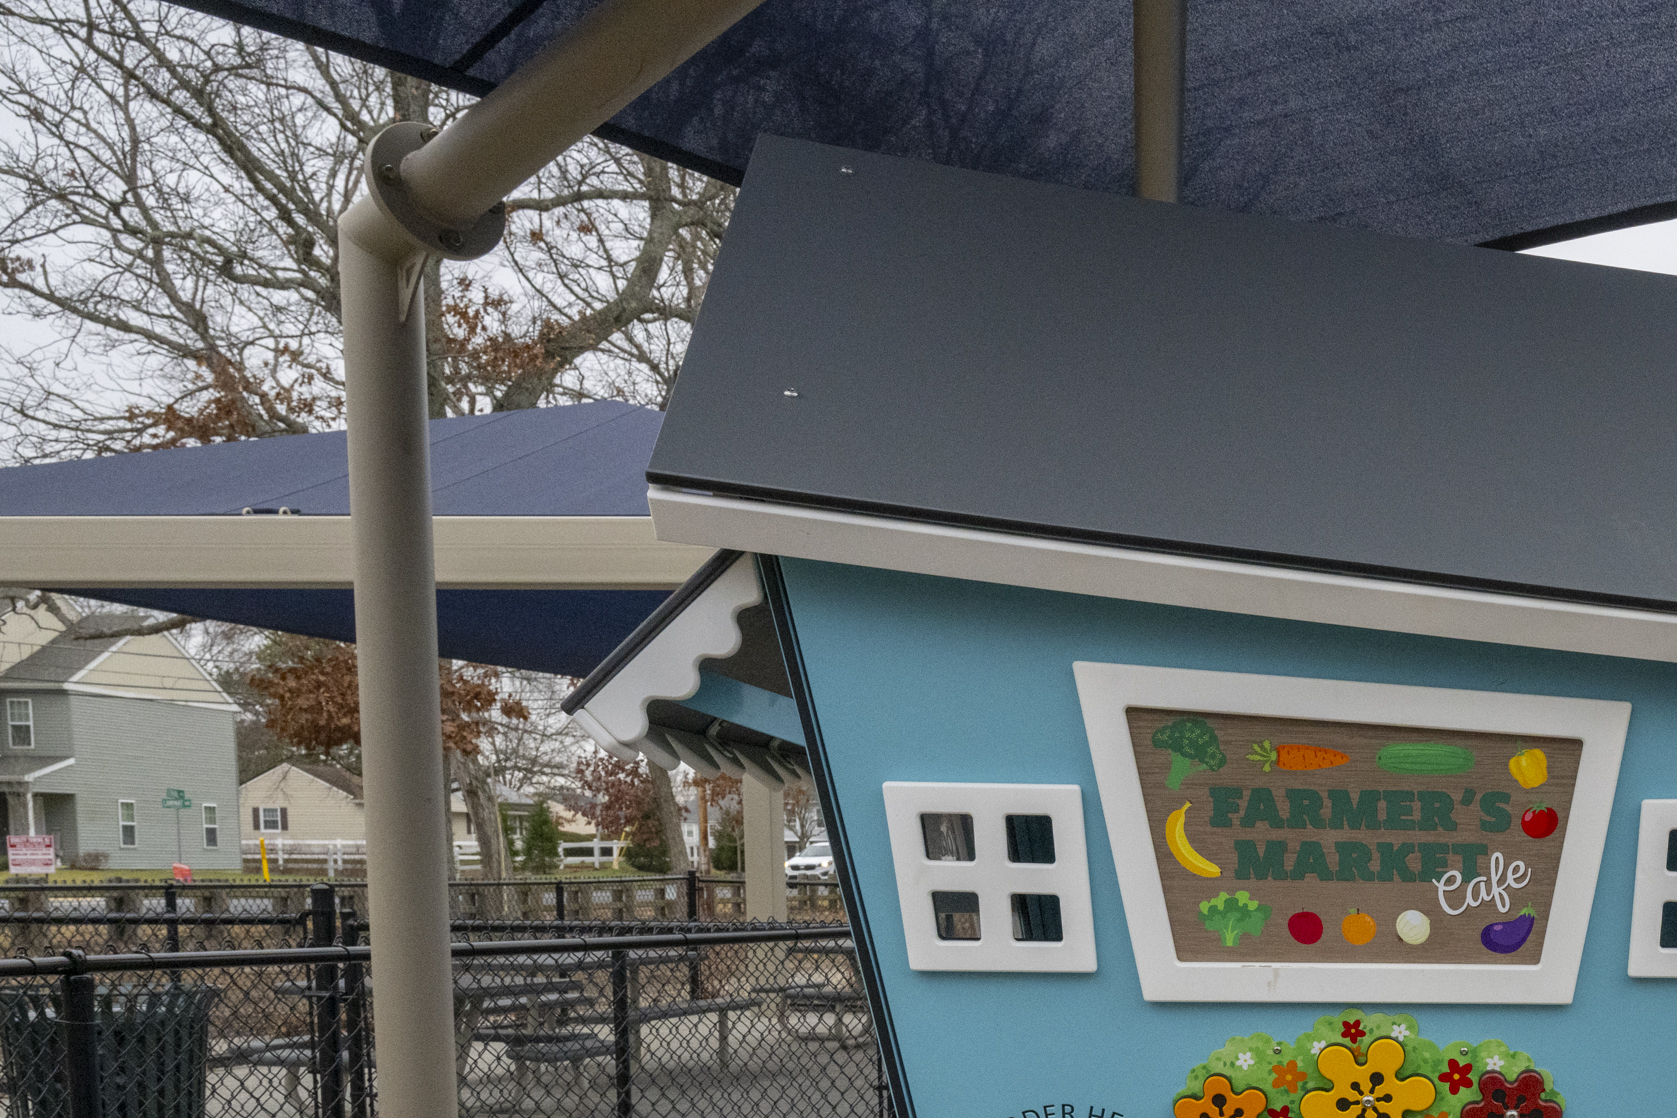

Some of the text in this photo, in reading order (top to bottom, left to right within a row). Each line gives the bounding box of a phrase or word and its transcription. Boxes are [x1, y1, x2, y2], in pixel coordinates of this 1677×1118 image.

[1208, 786, 1512, 833] FARMER'S
[1233, 839, 1489, 883] MARKET
[1431, 851, 1532, 916] Cafe
